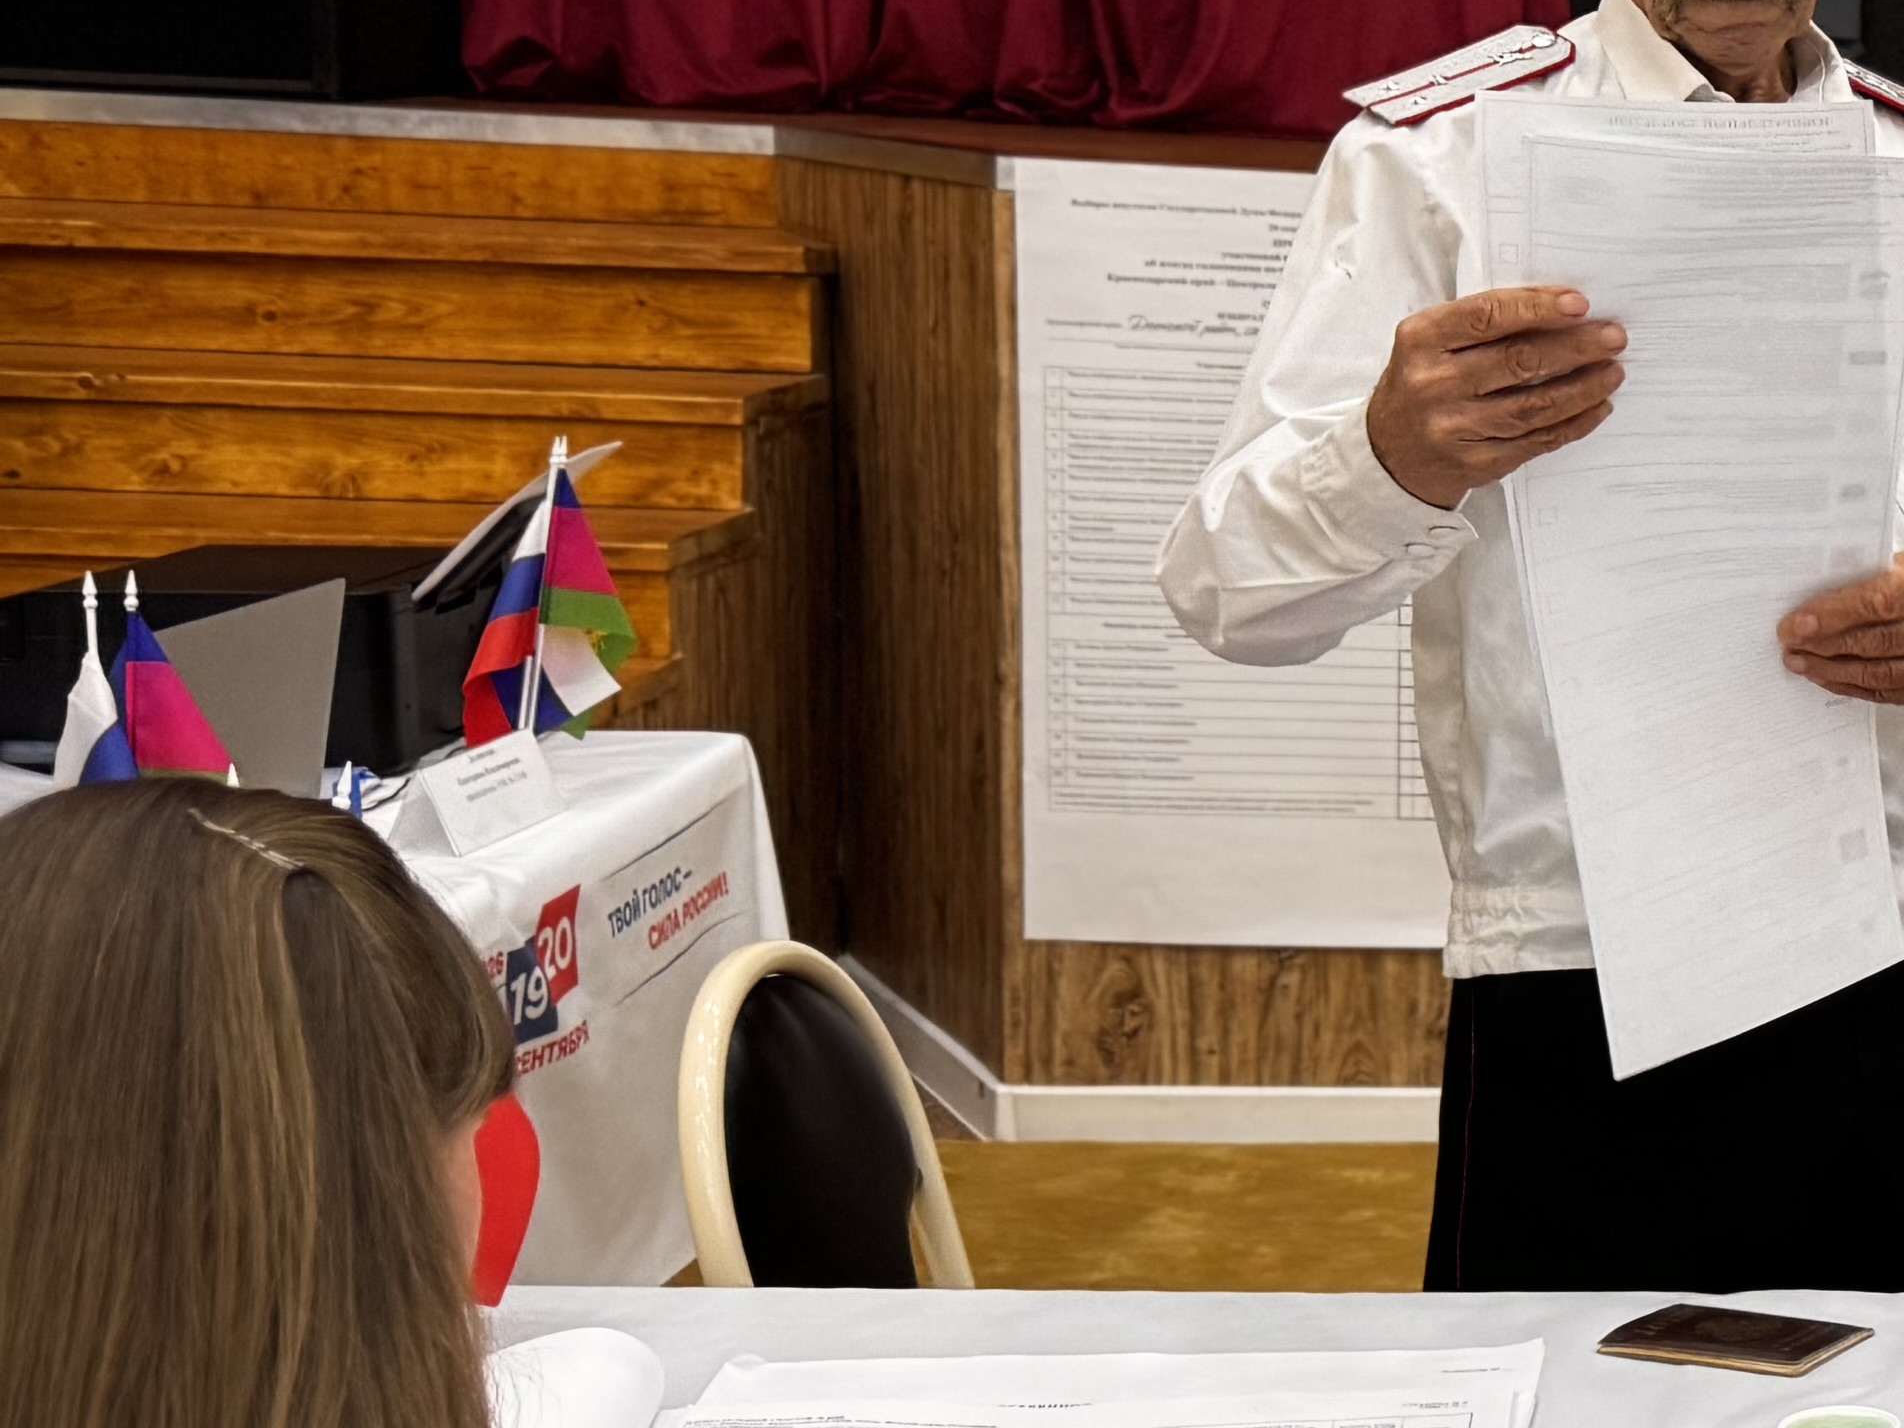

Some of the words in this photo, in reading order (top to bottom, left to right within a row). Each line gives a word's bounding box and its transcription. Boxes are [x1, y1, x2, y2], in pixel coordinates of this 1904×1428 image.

[608, 889, 641, 938] ТВОЙ
[642, 866, 681, 914] ГОЛОС
[648, 908, 681, 950] СИЛА
[682, 871, 729, 927] РОССИИ!
[536, 916, 573, 981] 20
[510, 965, 549, 1026] 19
